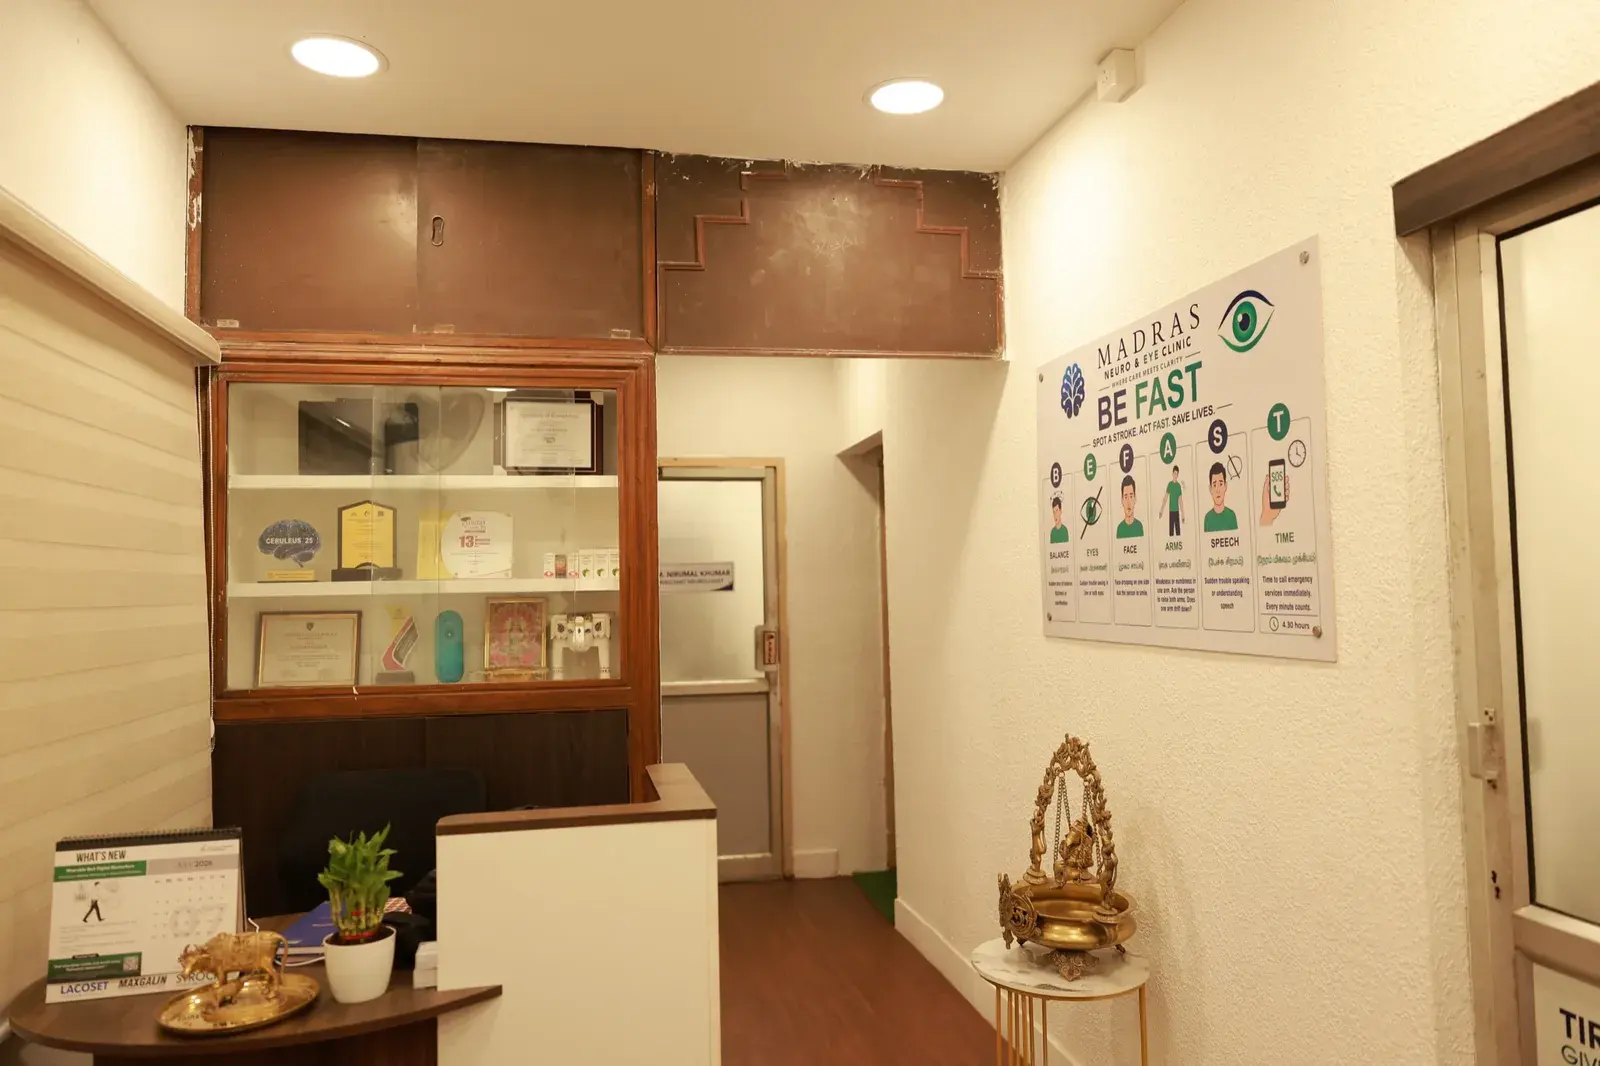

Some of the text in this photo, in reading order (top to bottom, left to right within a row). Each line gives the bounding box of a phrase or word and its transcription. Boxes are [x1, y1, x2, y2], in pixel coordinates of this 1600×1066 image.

[1097, 303, 1200, 369] MADRAS
[1104, 336, 1192, 380] NEURO & EYE CLINIC
[1128, 371, 1141, 382] CARE
[1143, 366, 1159, 377] MEETS
[1160, 356, 1183, 370] CLARITY
[1098, 360, 1203, 431] BE FAST
[1092, 404, 1216, 448] SPOT A STROKE. ACT FAST. SAVE LIVES.
[1272, 410, 1284, 433] T
[1213, 426, 1223, 447] S
[1163, 439, 1173, 458] A
[1123, 450, 1130, 468] F
[1086, 459, 1093, 475] E
[1052, 467, 1060, 483] B
[1271, 471, 1284, 482] SOS
[459, 535, 474, 548] 13
[1211, 536, 1240, 548] SPEECH
[1275, 532, 1295, 543] TIME
[1086, 548, 1099, 557] EYES
[1123, 545, 1137, 554] FACE
[1165, 541, 1183, 551] ARMS
[1049, 550, 1070, 559] BALANCE
[1232, 577, 1250, 585] speaking
[1262, 575, 1273, 583] Time
[1279, 575, 1287, 583] call
[1288, 576, 1313, 584] emergency
[1216, 590, 1243, 598] understanding
[1264, 588, 1282, 596] services
[1266, 602, 1279, 611] Every
[1279, 602, 1294, 610] minute
[1282, 621, 1310, 629] 4.30 hours
[76, 849, 126, 862] WHAT'S NEW
[60, 972, 218, 995] LACOSET MAXGALIN SROC
